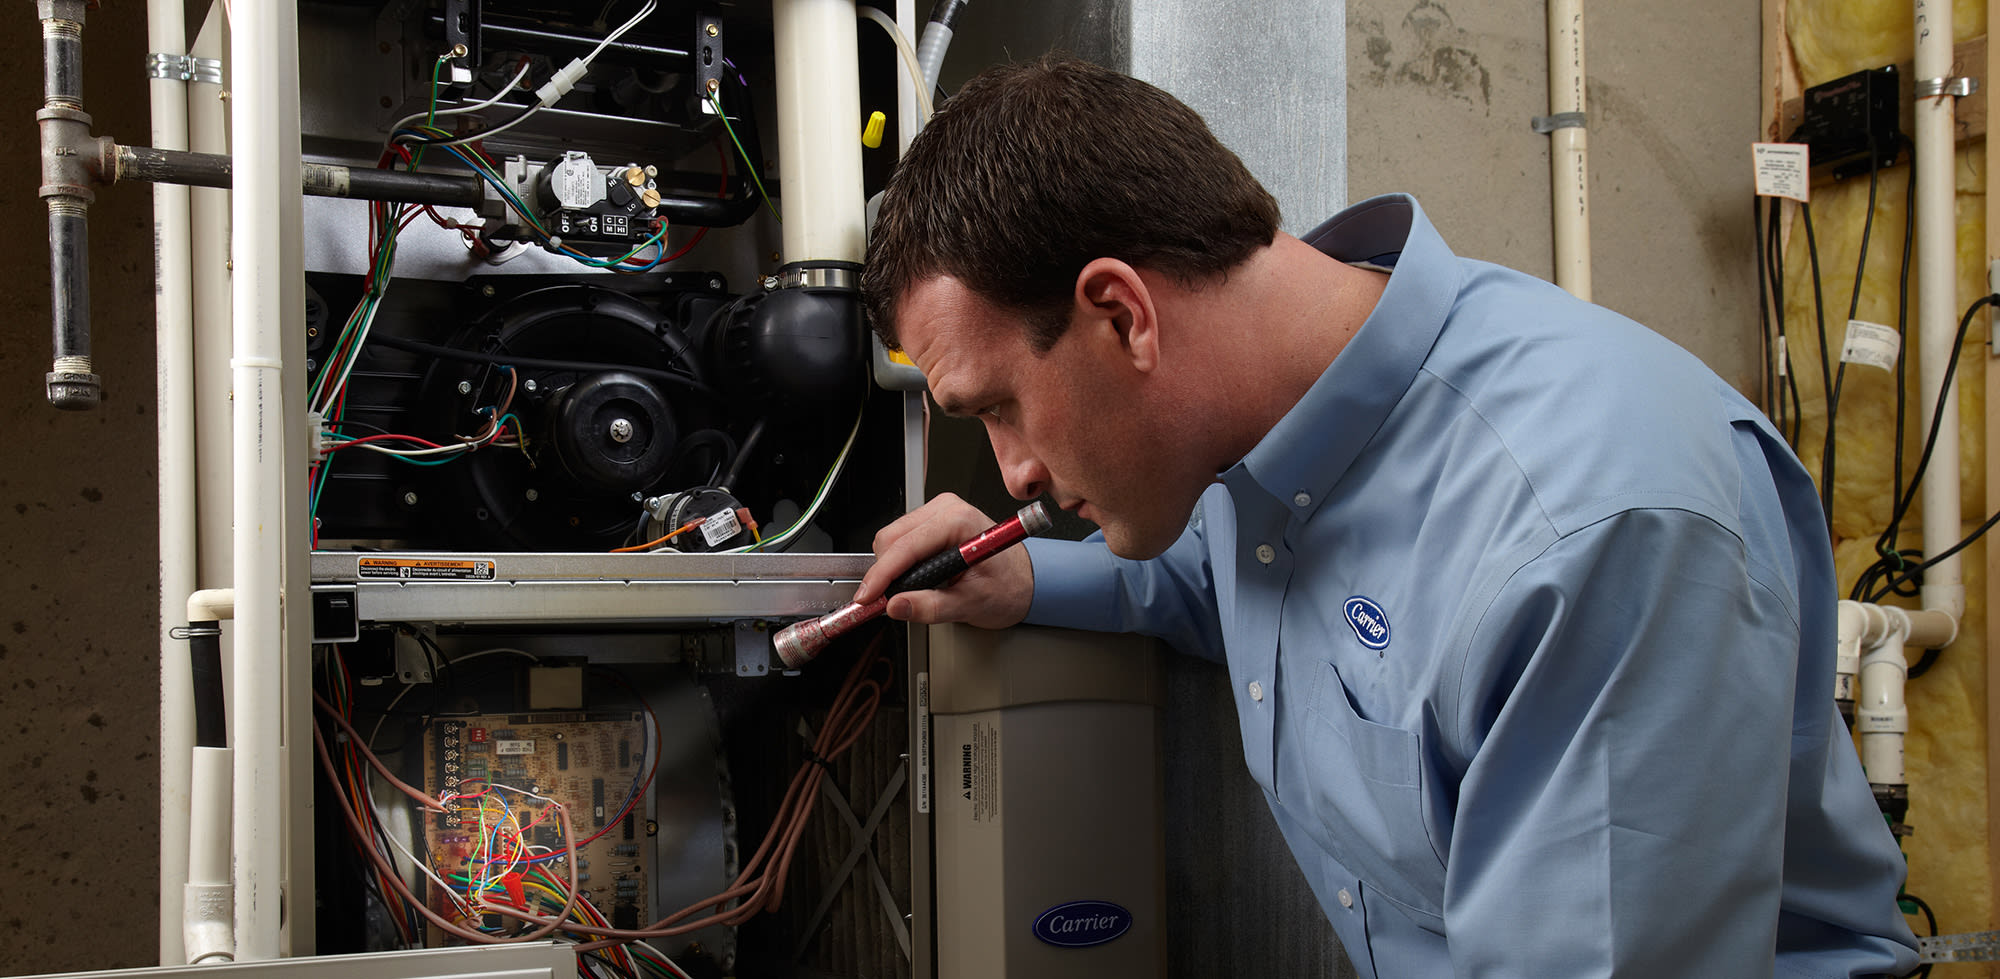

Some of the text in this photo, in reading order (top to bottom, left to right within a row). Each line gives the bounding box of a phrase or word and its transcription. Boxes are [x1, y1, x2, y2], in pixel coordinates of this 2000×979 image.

[608, 179, 617, 188] HI
[626, 203, 636, 212] LO
[561, 213, 570, 233] OFF
[589, 217, 598, 232] ON
[1351, 603, 1386, 639] Carrier
[962, 744, 971, 790] WARNING
[1049, 913, 1119, 934] Carrier
